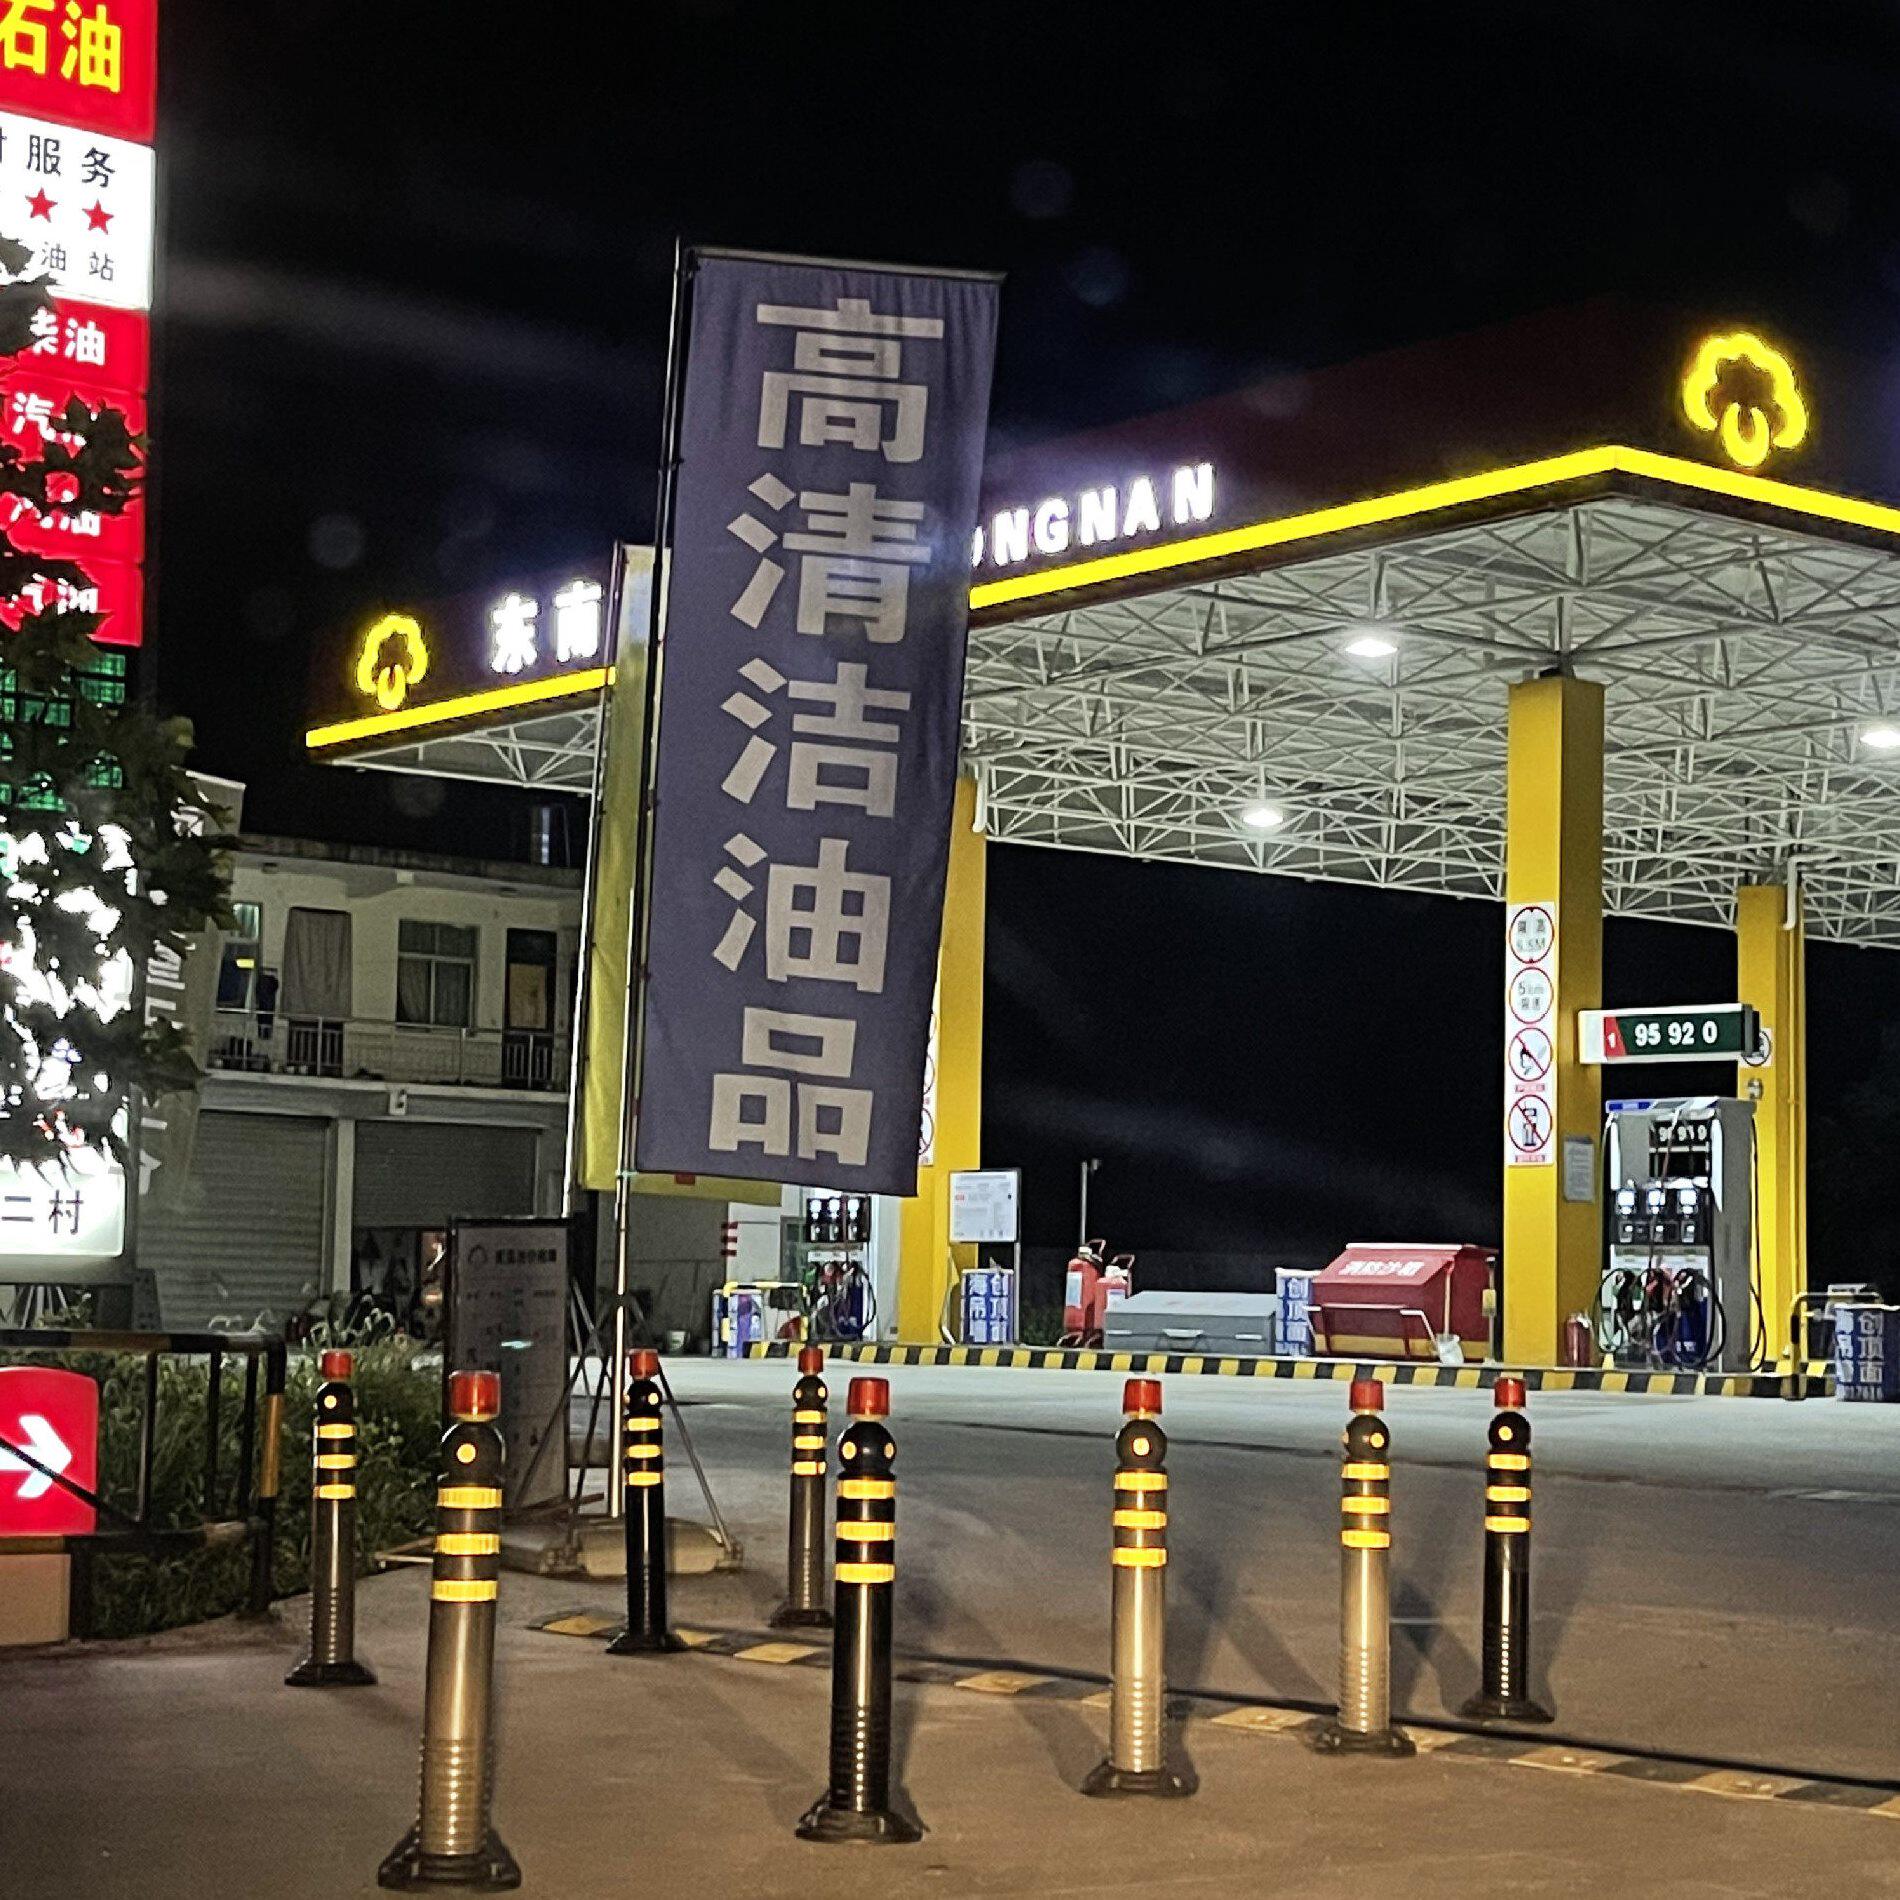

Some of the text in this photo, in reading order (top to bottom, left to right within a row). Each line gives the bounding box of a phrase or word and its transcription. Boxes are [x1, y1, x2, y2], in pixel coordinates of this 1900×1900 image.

[0, 0, 121, 92] 石油
[0, 127, 116, 187] 服务
[491, 579, 603, 674] 东南
[709, 297, 945, 1166] 高清洁油品
[1607, 1032, 1616, 1049] 1
[1634, 1020, 1718, 1046] 95 92 0
[1, 1189, 85, 1236] 二村
